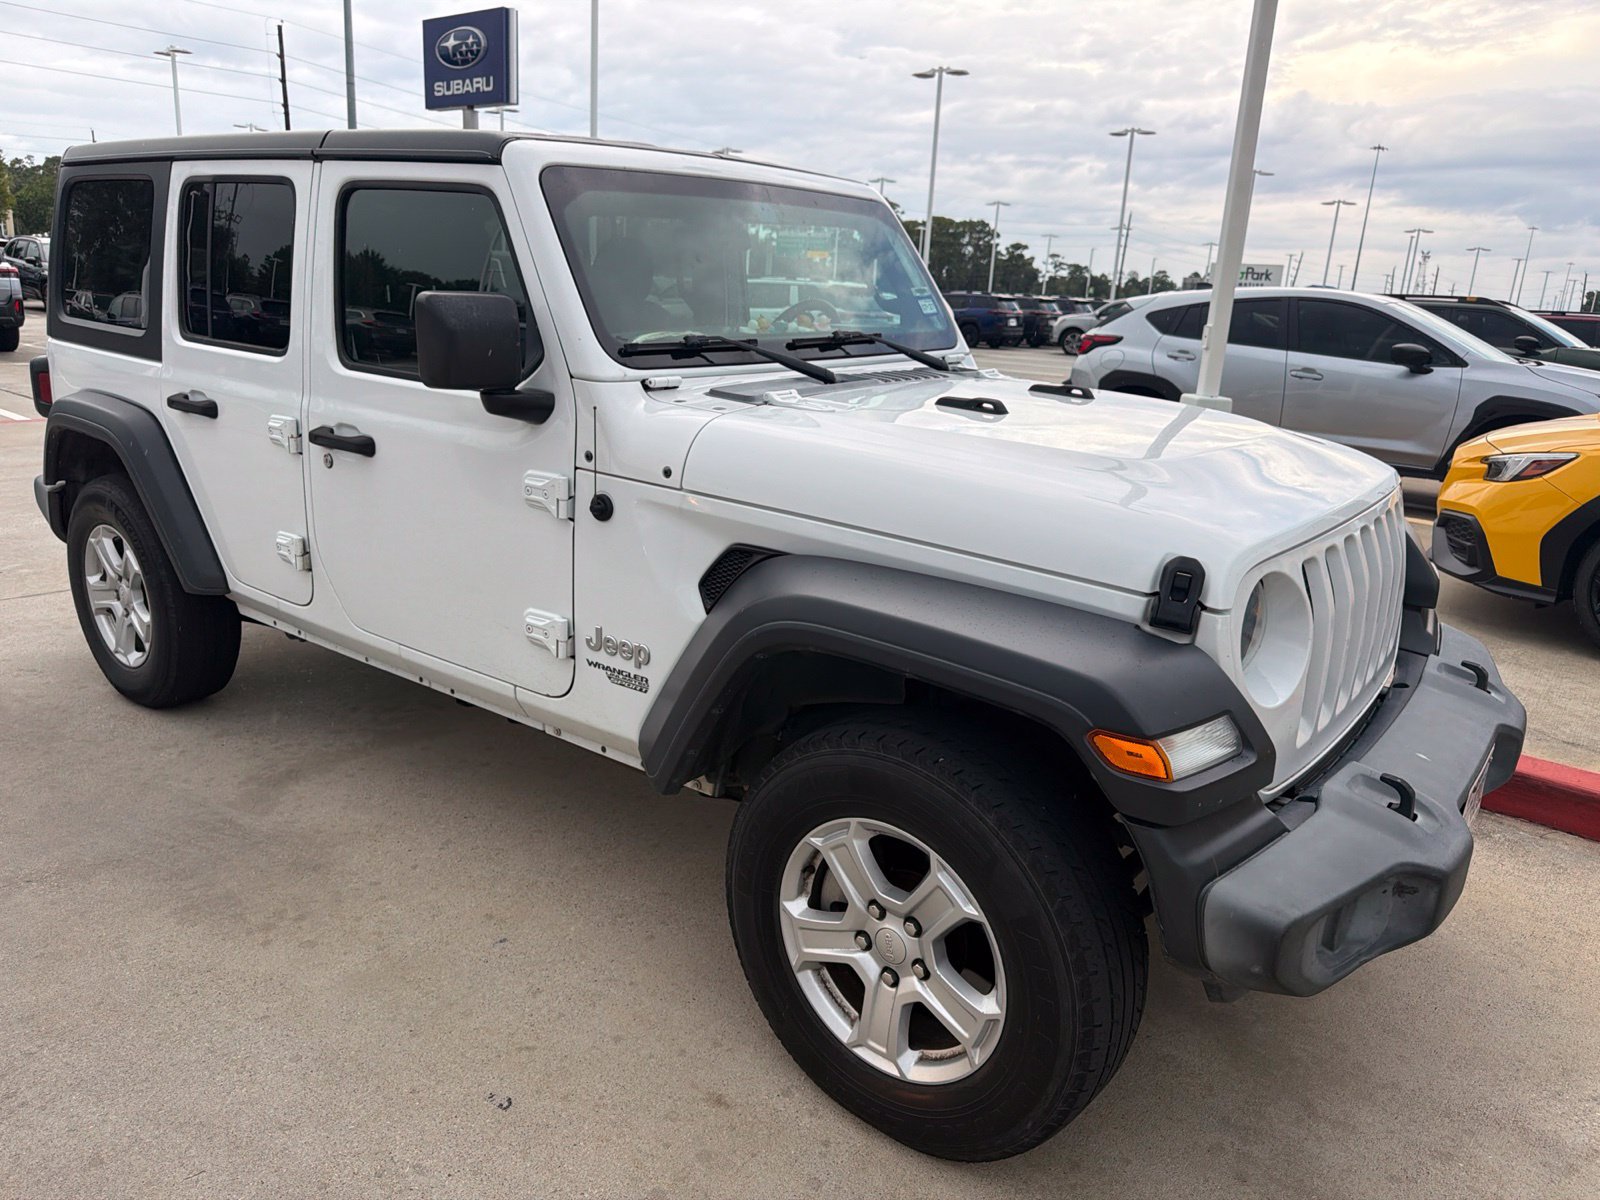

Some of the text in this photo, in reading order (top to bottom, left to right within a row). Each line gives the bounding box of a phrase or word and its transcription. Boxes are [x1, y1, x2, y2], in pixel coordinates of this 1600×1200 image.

[434, 76, 493, 97] SUBARU
[585, 625, 650, 669] Jeep
[586, 658, 649, 684] WRANGLER
